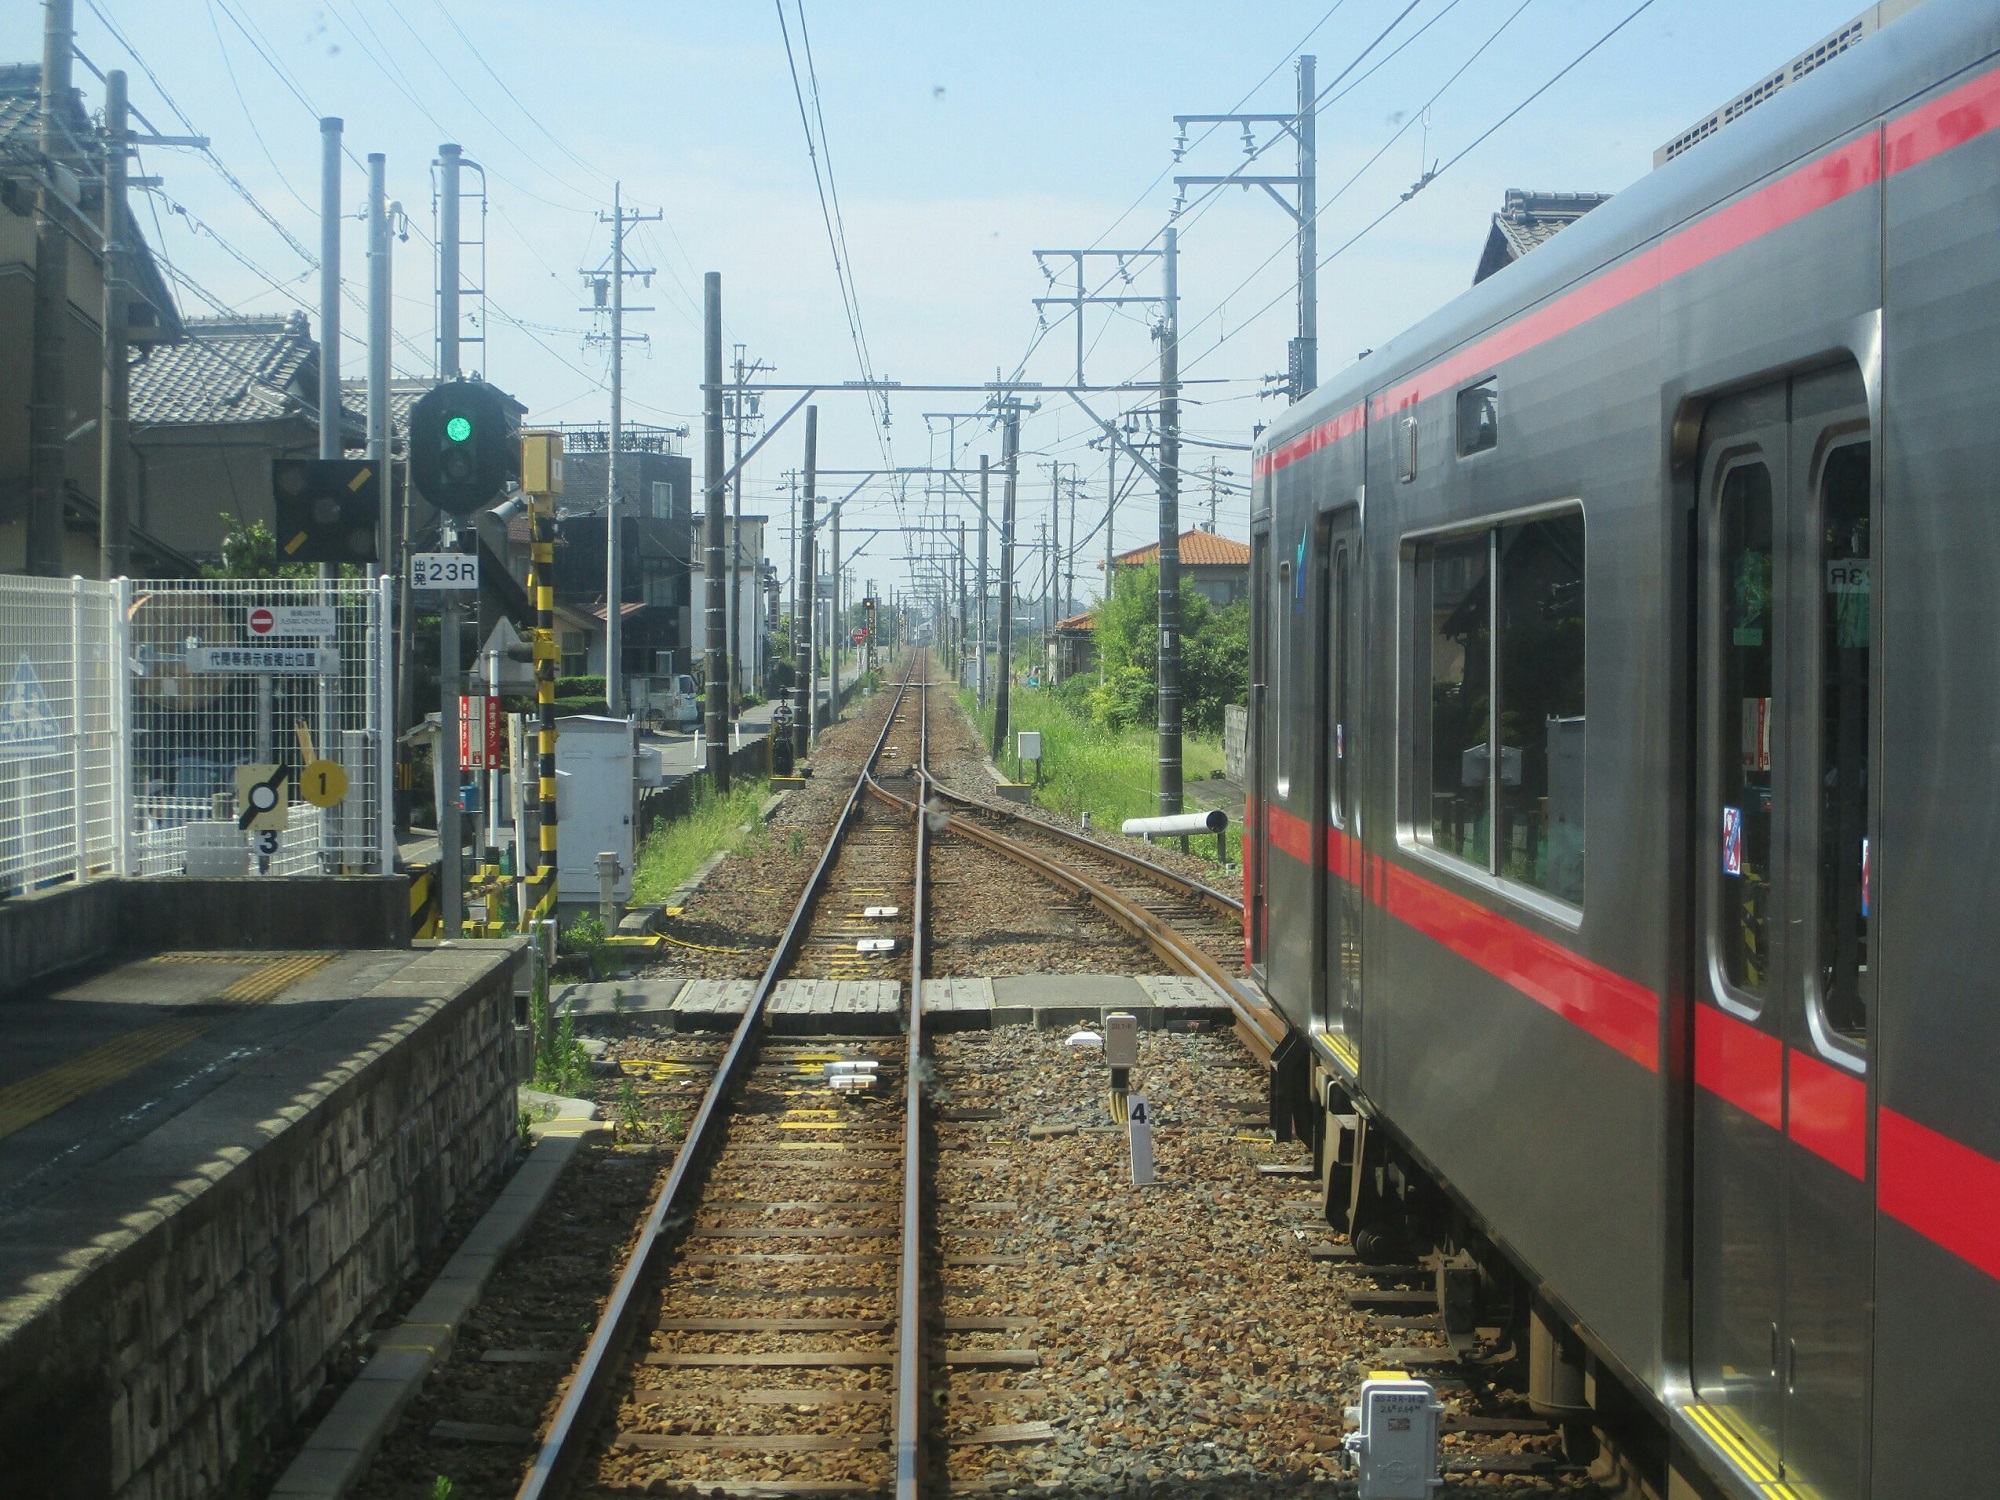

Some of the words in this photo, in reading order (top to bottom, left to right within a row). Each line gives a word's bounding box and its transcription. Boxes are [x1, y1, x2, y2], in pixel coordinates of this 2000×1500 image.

[413, 560, 427, 586] 出発
[429, 563, 475, 581] 23R
[318, 772, 327, 796] 1
[259, 829, 278, 854] 3
[1131, 1103, 1147, 1124] 4
